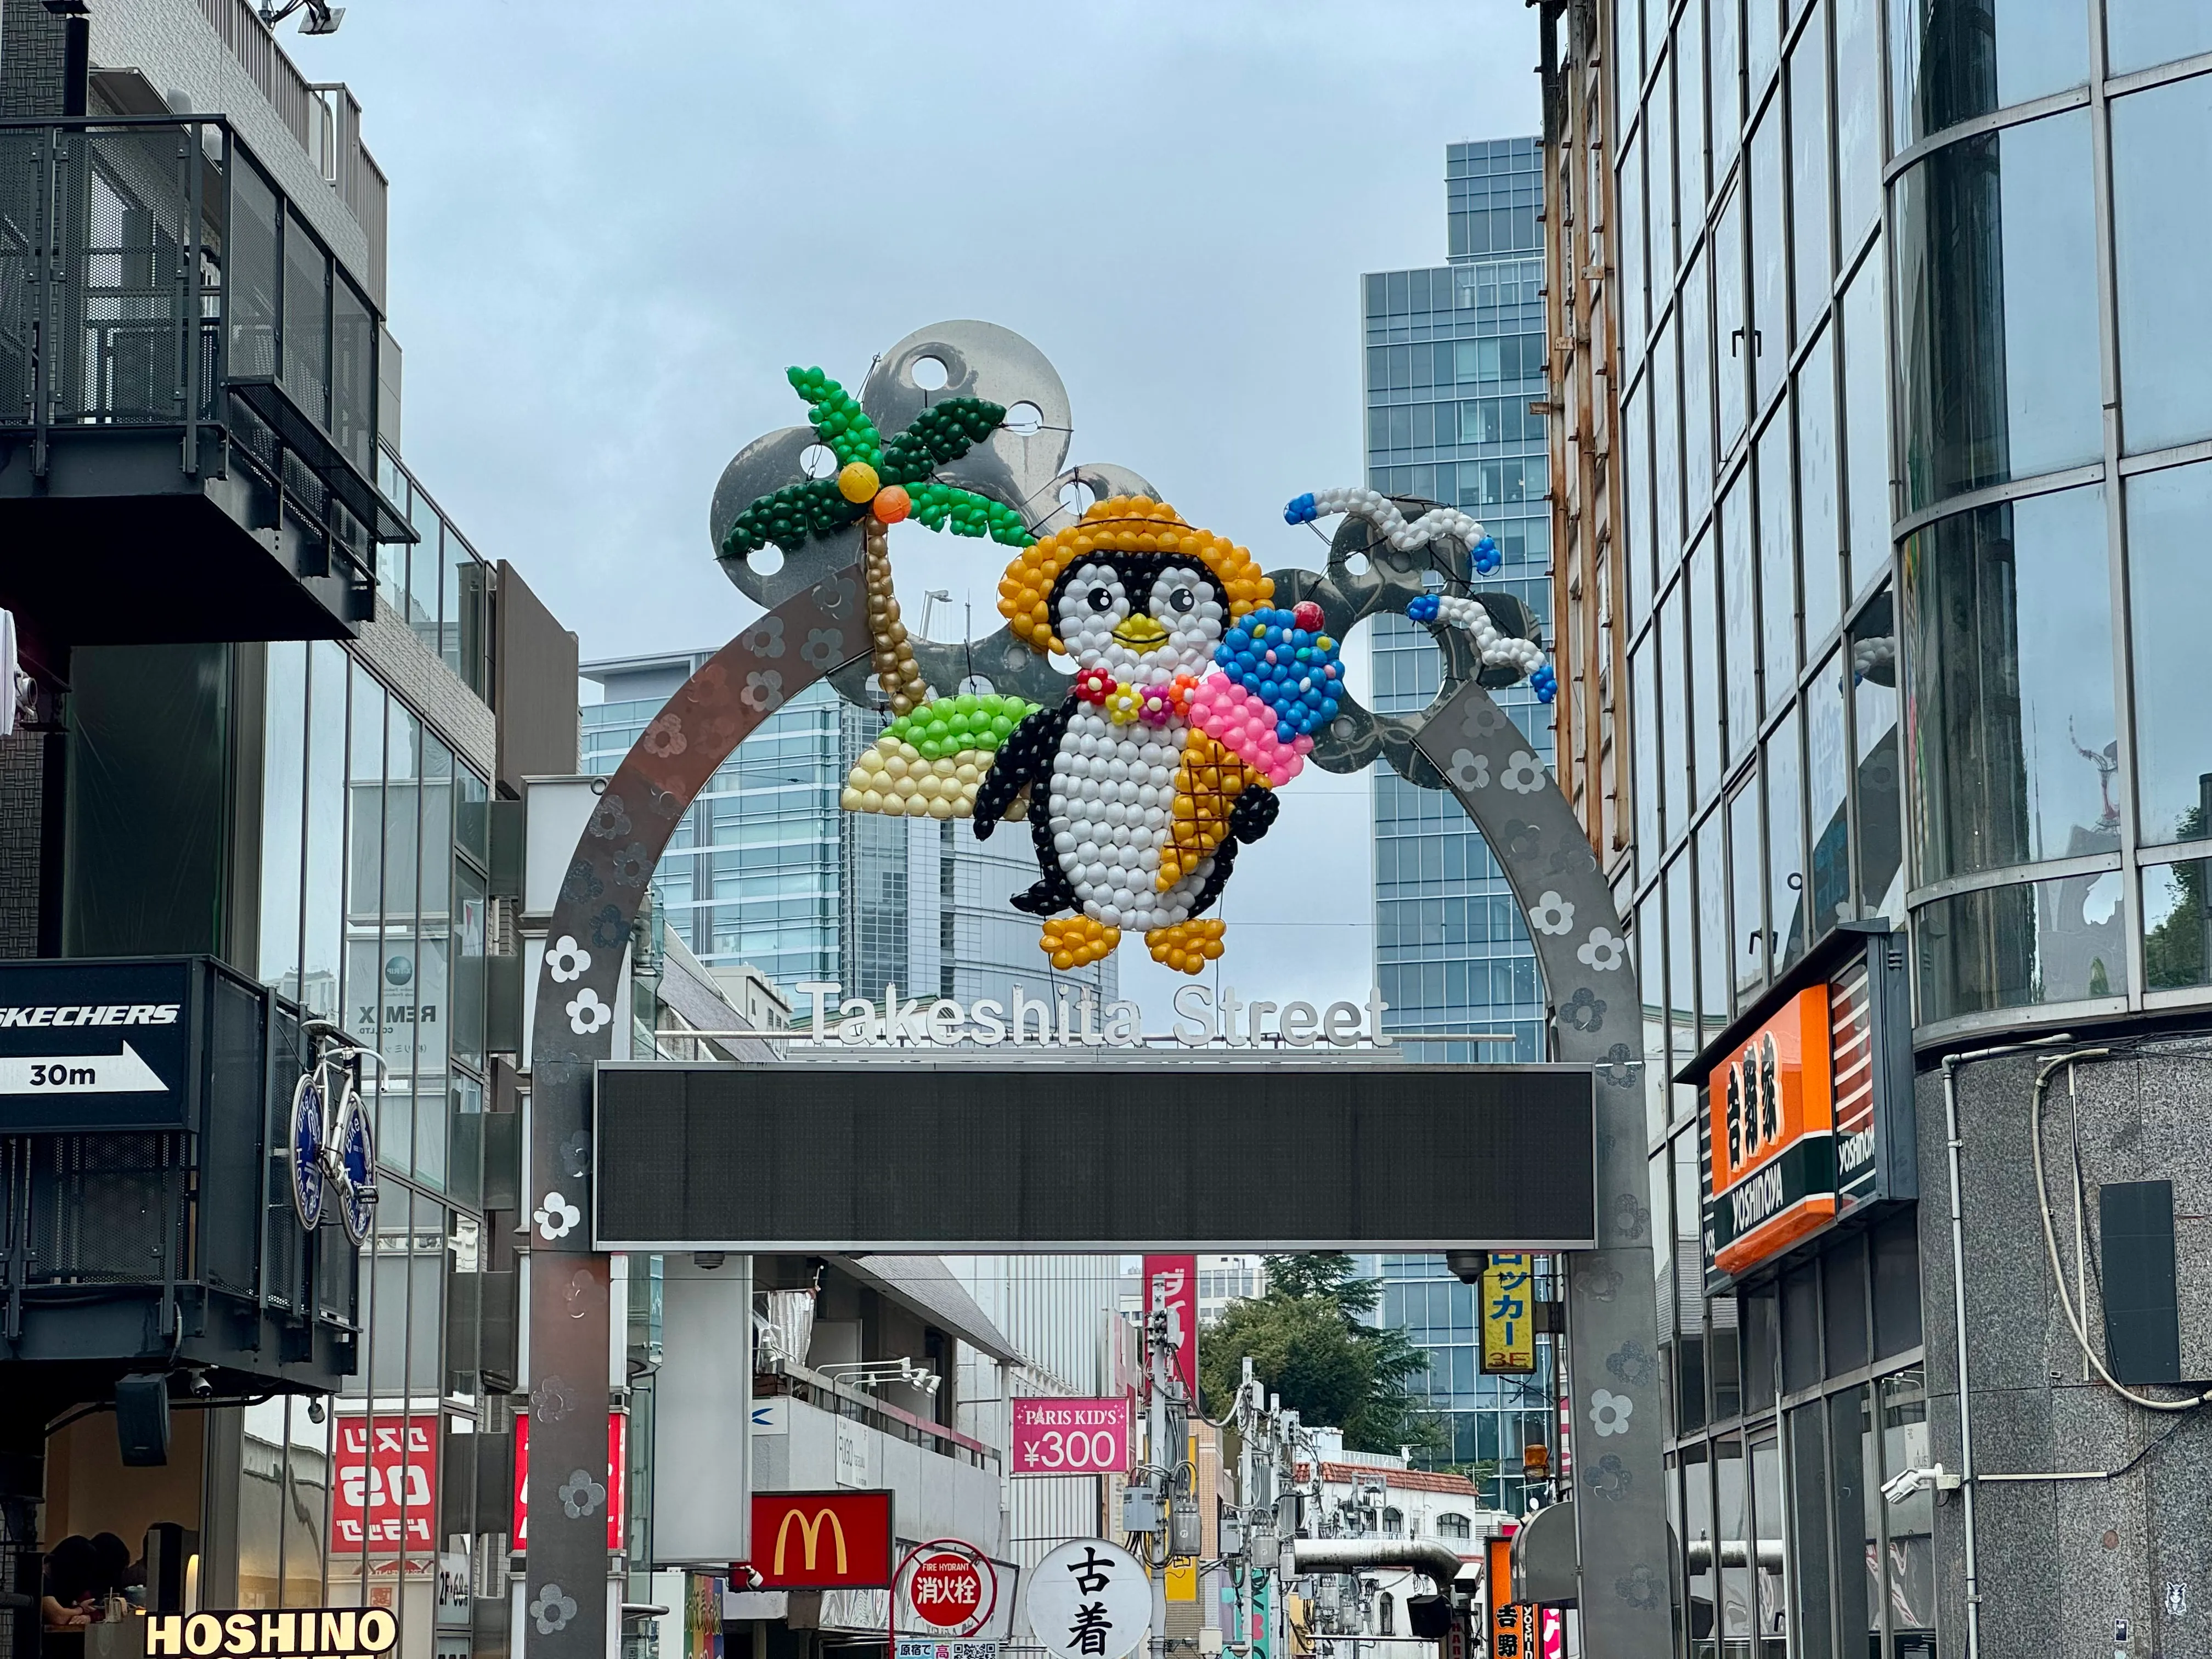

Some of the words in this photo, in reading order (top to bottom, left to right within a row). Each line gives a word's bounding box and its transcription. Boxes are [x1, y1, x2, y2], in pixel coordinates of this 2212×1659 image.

[795, 981, 1142, 1046] Takeshita
[1173, 984, 1393, 1046] Street
[30, 1064, 95, 1086] 30m
[346, 1118, 360, 1154] Bike
[1732, 1162, 1784, 1236] YOSHINOYA
[1487, 1352, 1530, 1368] 3F
[1025, 1404, 1071, 1425] PARIS
[1075, 1410, 1117, 1425] KID'S
[1023, 1431, 1115, 1468] ¥300
[923, 1563, 937, 1571] FIRE
[939, 1563, 969, 1571] HYDRANT
[917, 1576, 977, 1604] 消火栓
[1065, 1547, 1116, 1656] 古着
[147, 1610, 396, 1655] HOSHINO
[1496, 1603, 1519, 1658] 吉野
[900, 1644, 932, 1656] 原宿で
